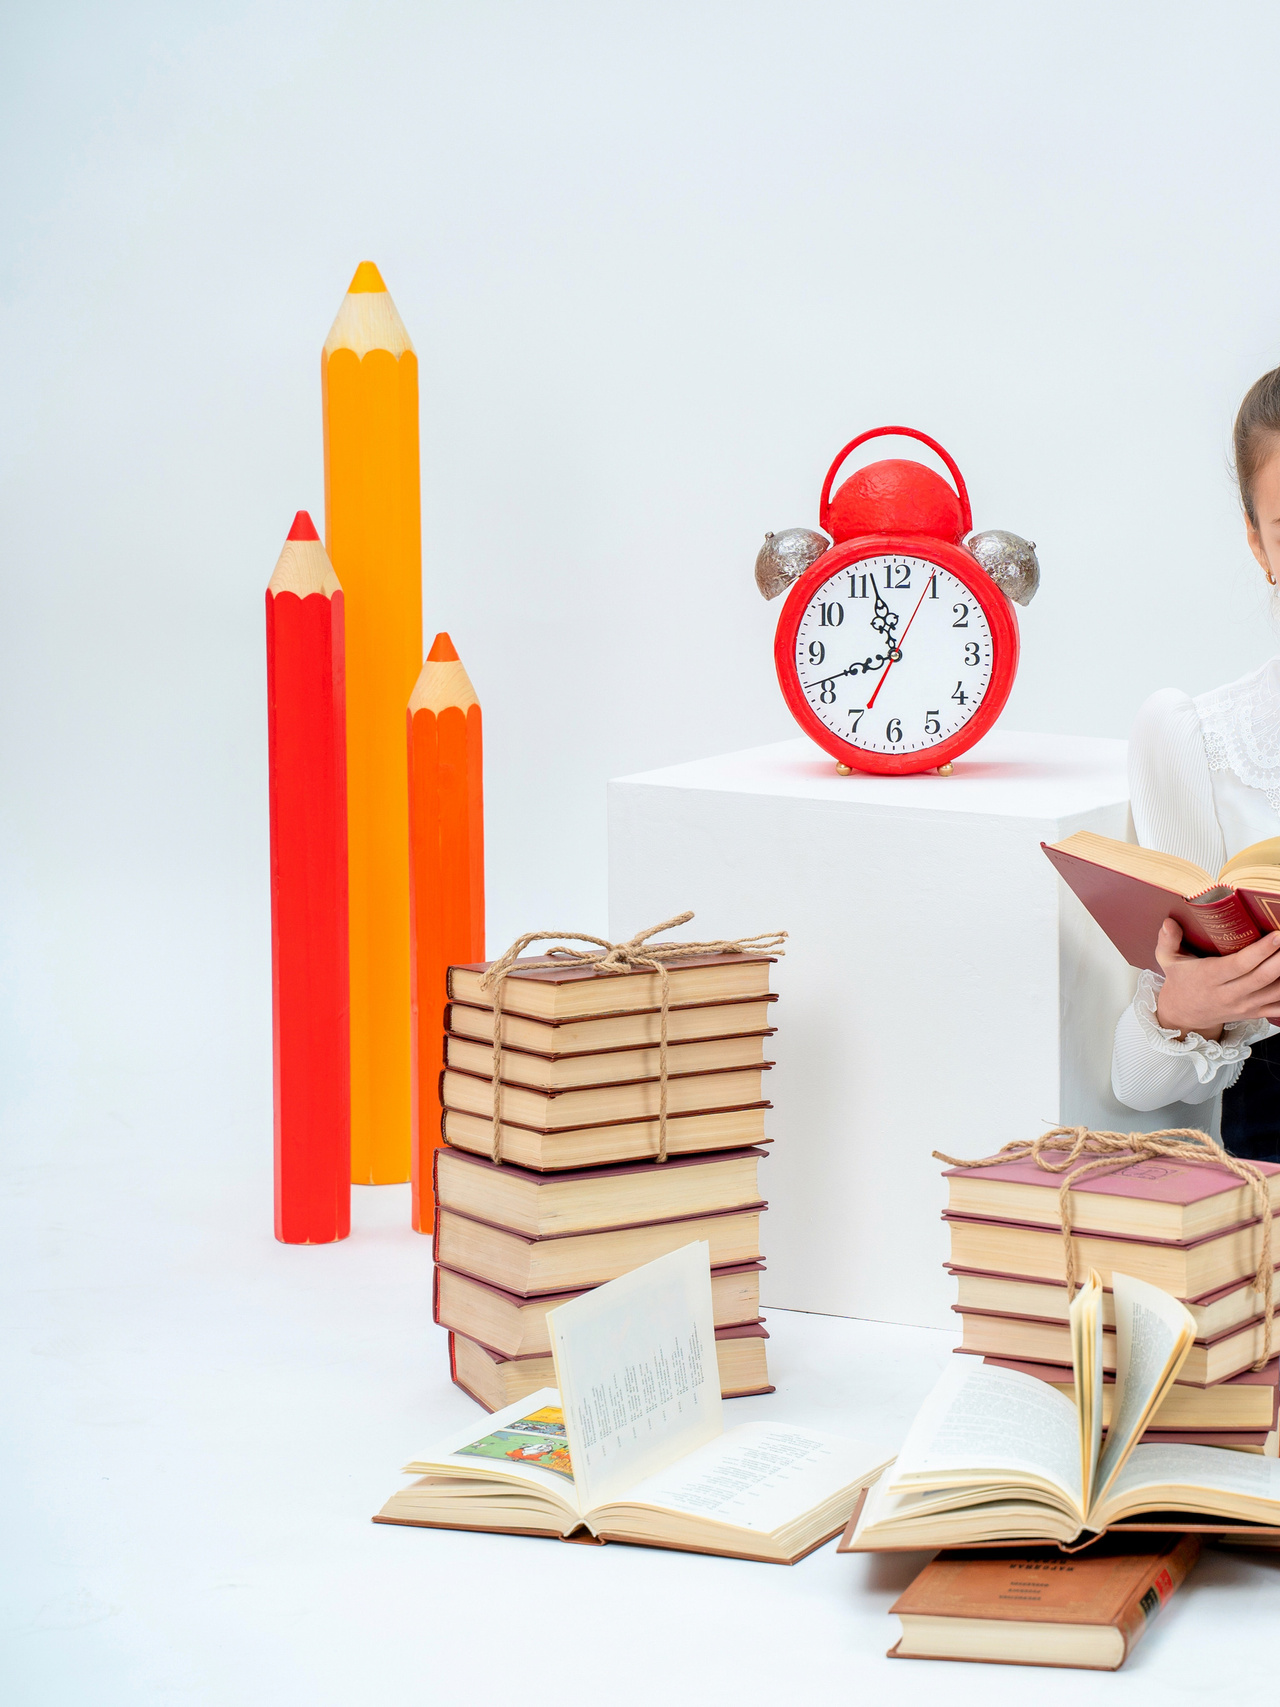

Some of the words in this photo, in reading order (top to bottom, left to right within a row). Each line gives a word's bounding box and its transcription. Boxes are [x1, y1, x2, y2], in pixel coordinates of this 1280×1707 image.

[847, 574, 870, 599] 11
[883, 564, 911, 589] 12
[928, 574, 940, 599] 1
[818, 602, 844, 627] 10
[952, 603, 969, 628] 2
[808, 641, 826, 665] 9
[964, 642, 980, 666] 3
[819, 679, 837, 704] 8
[951, 681, 969, 706] 4
[848, 709, 865, 733] 7
[886, 718, 903, 743] 6
[924, 709, 941, 735] 5
